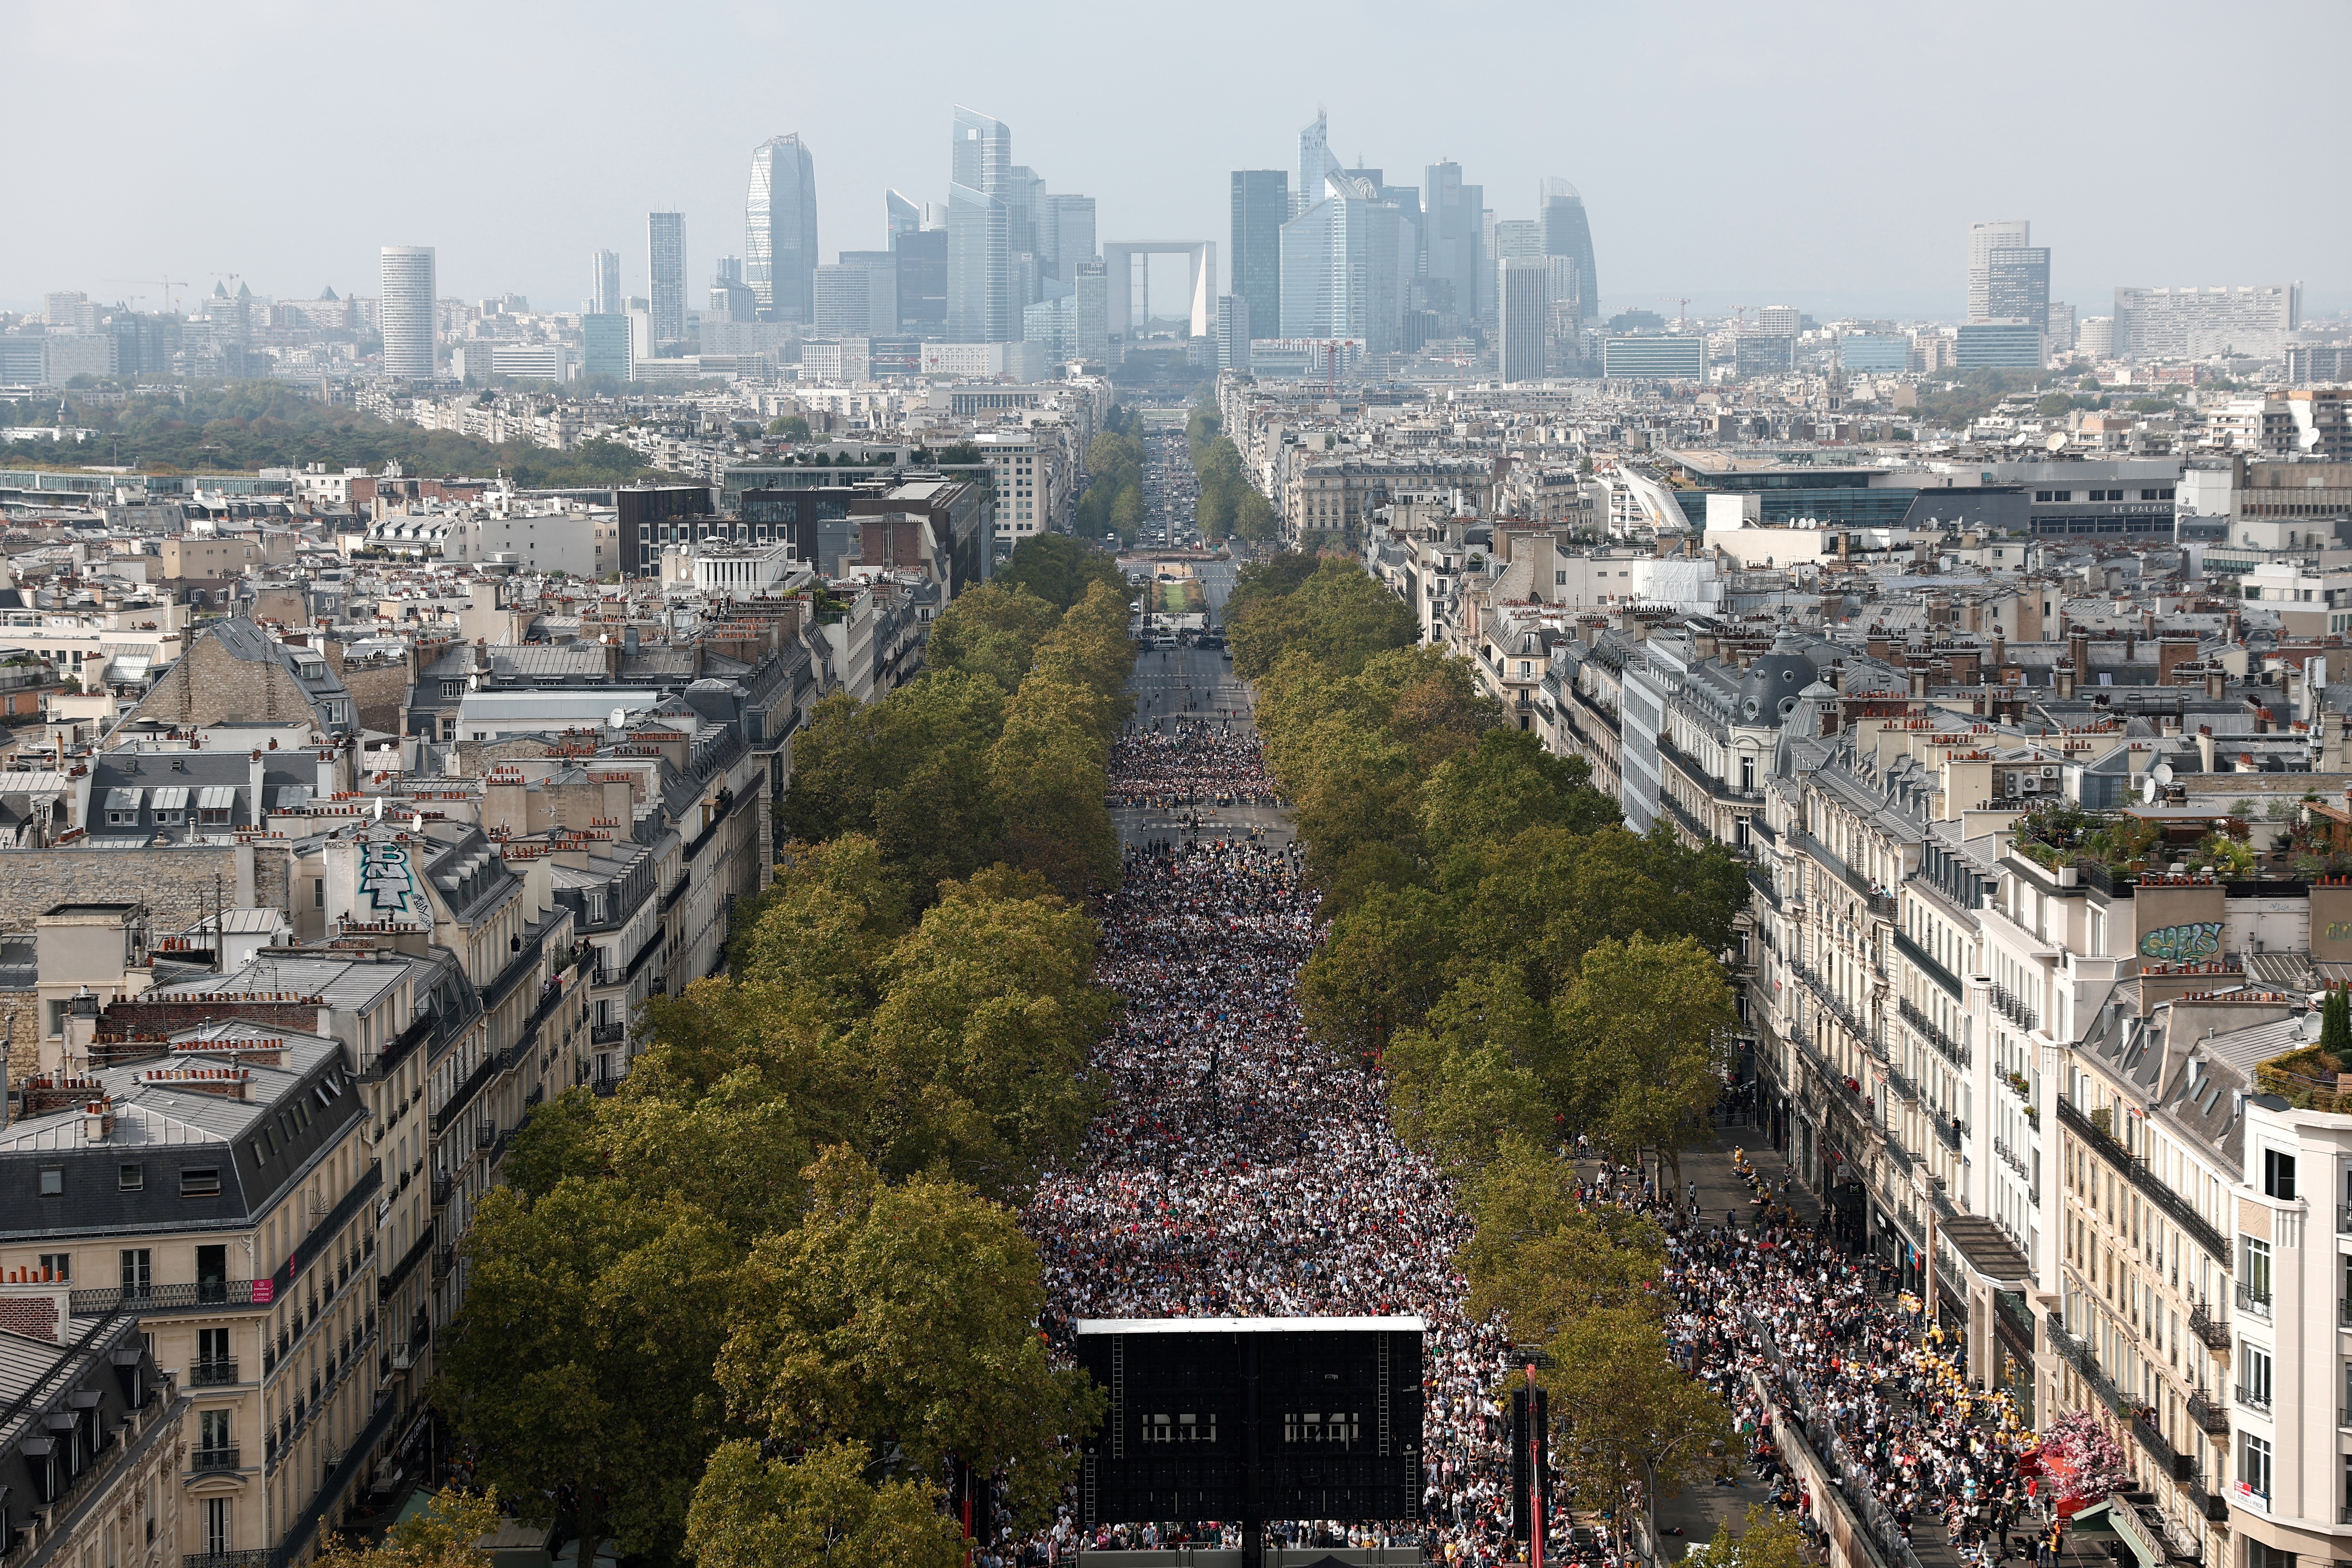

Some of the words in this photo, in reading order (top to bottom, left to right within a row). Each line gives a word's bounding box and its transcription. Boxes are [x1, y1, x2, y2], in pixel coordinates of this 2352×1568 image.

[401, 1432, 413, 1457] OPTICAL
[414, 1414, 425, 1438] CENTER
[2237, 1494, 2249, 1503] BUREAU
[2253, 1500, 2264, 1510] VENDRE
[2133, 1522, 2162, 1564] CRISTAL
